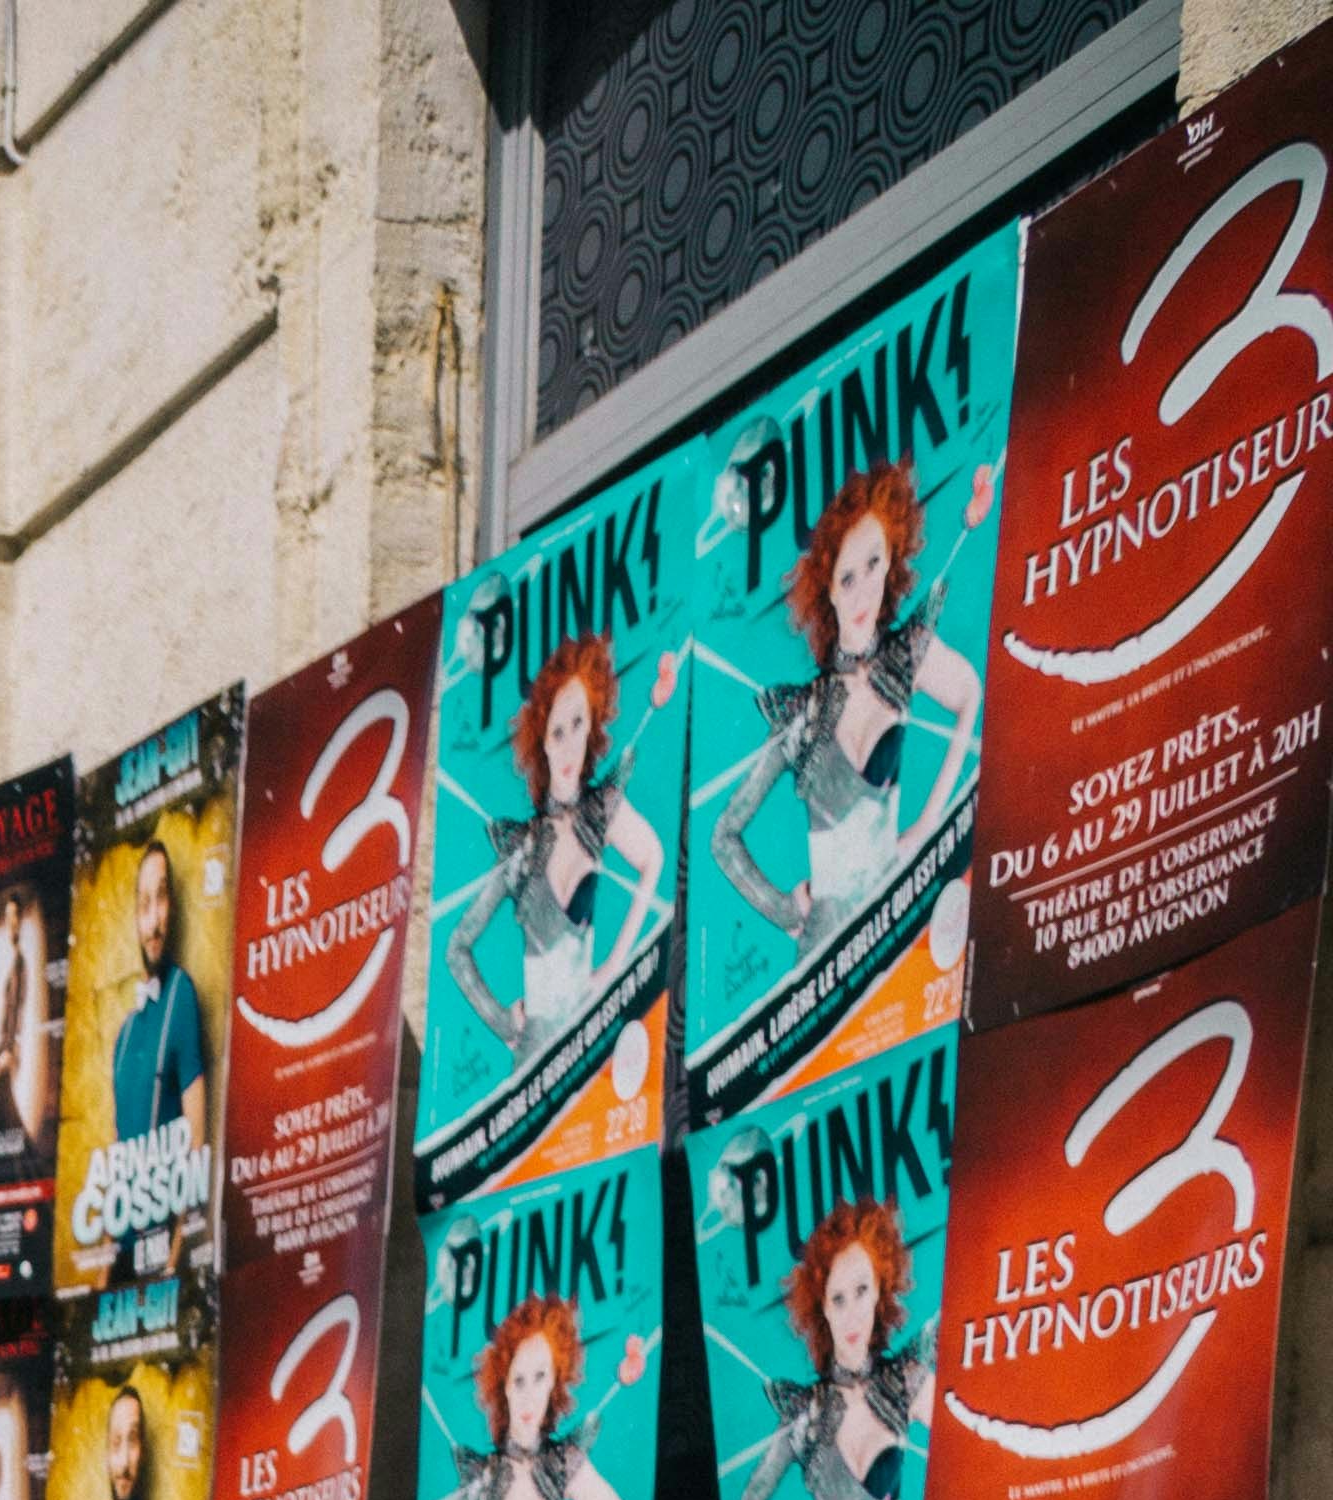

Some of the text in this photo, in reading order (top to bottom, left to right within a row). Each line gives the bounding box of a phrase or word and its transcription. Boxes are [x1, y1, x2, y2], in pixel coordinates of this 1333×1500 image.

[1059, 436, 1133, 531] LES
[989, 703, 1323, 887] DU 6 AU 29 JUILLET À 20H
[1068, 748, 1156, 816] SOYEZ
[265, 870, 310, 929] LES
[1119, 865, 1145, 892] DE
[1128, 879, 1231, 946] AVIGNON
[1034, 928, 1058, 953] 10
[1061, 911, 1100, 944] RUE
[1105, 900, 1132, 926] DE
[87, 1117, 192, 1196] ARNAUD
[71, 1145, 211, 1246] COSSON
[962, 1232, 1267, 1370] HYPNOTISEURS
[995, 1232, 1077, 1305] LES
[240, 1449, 278, 1497] LES
